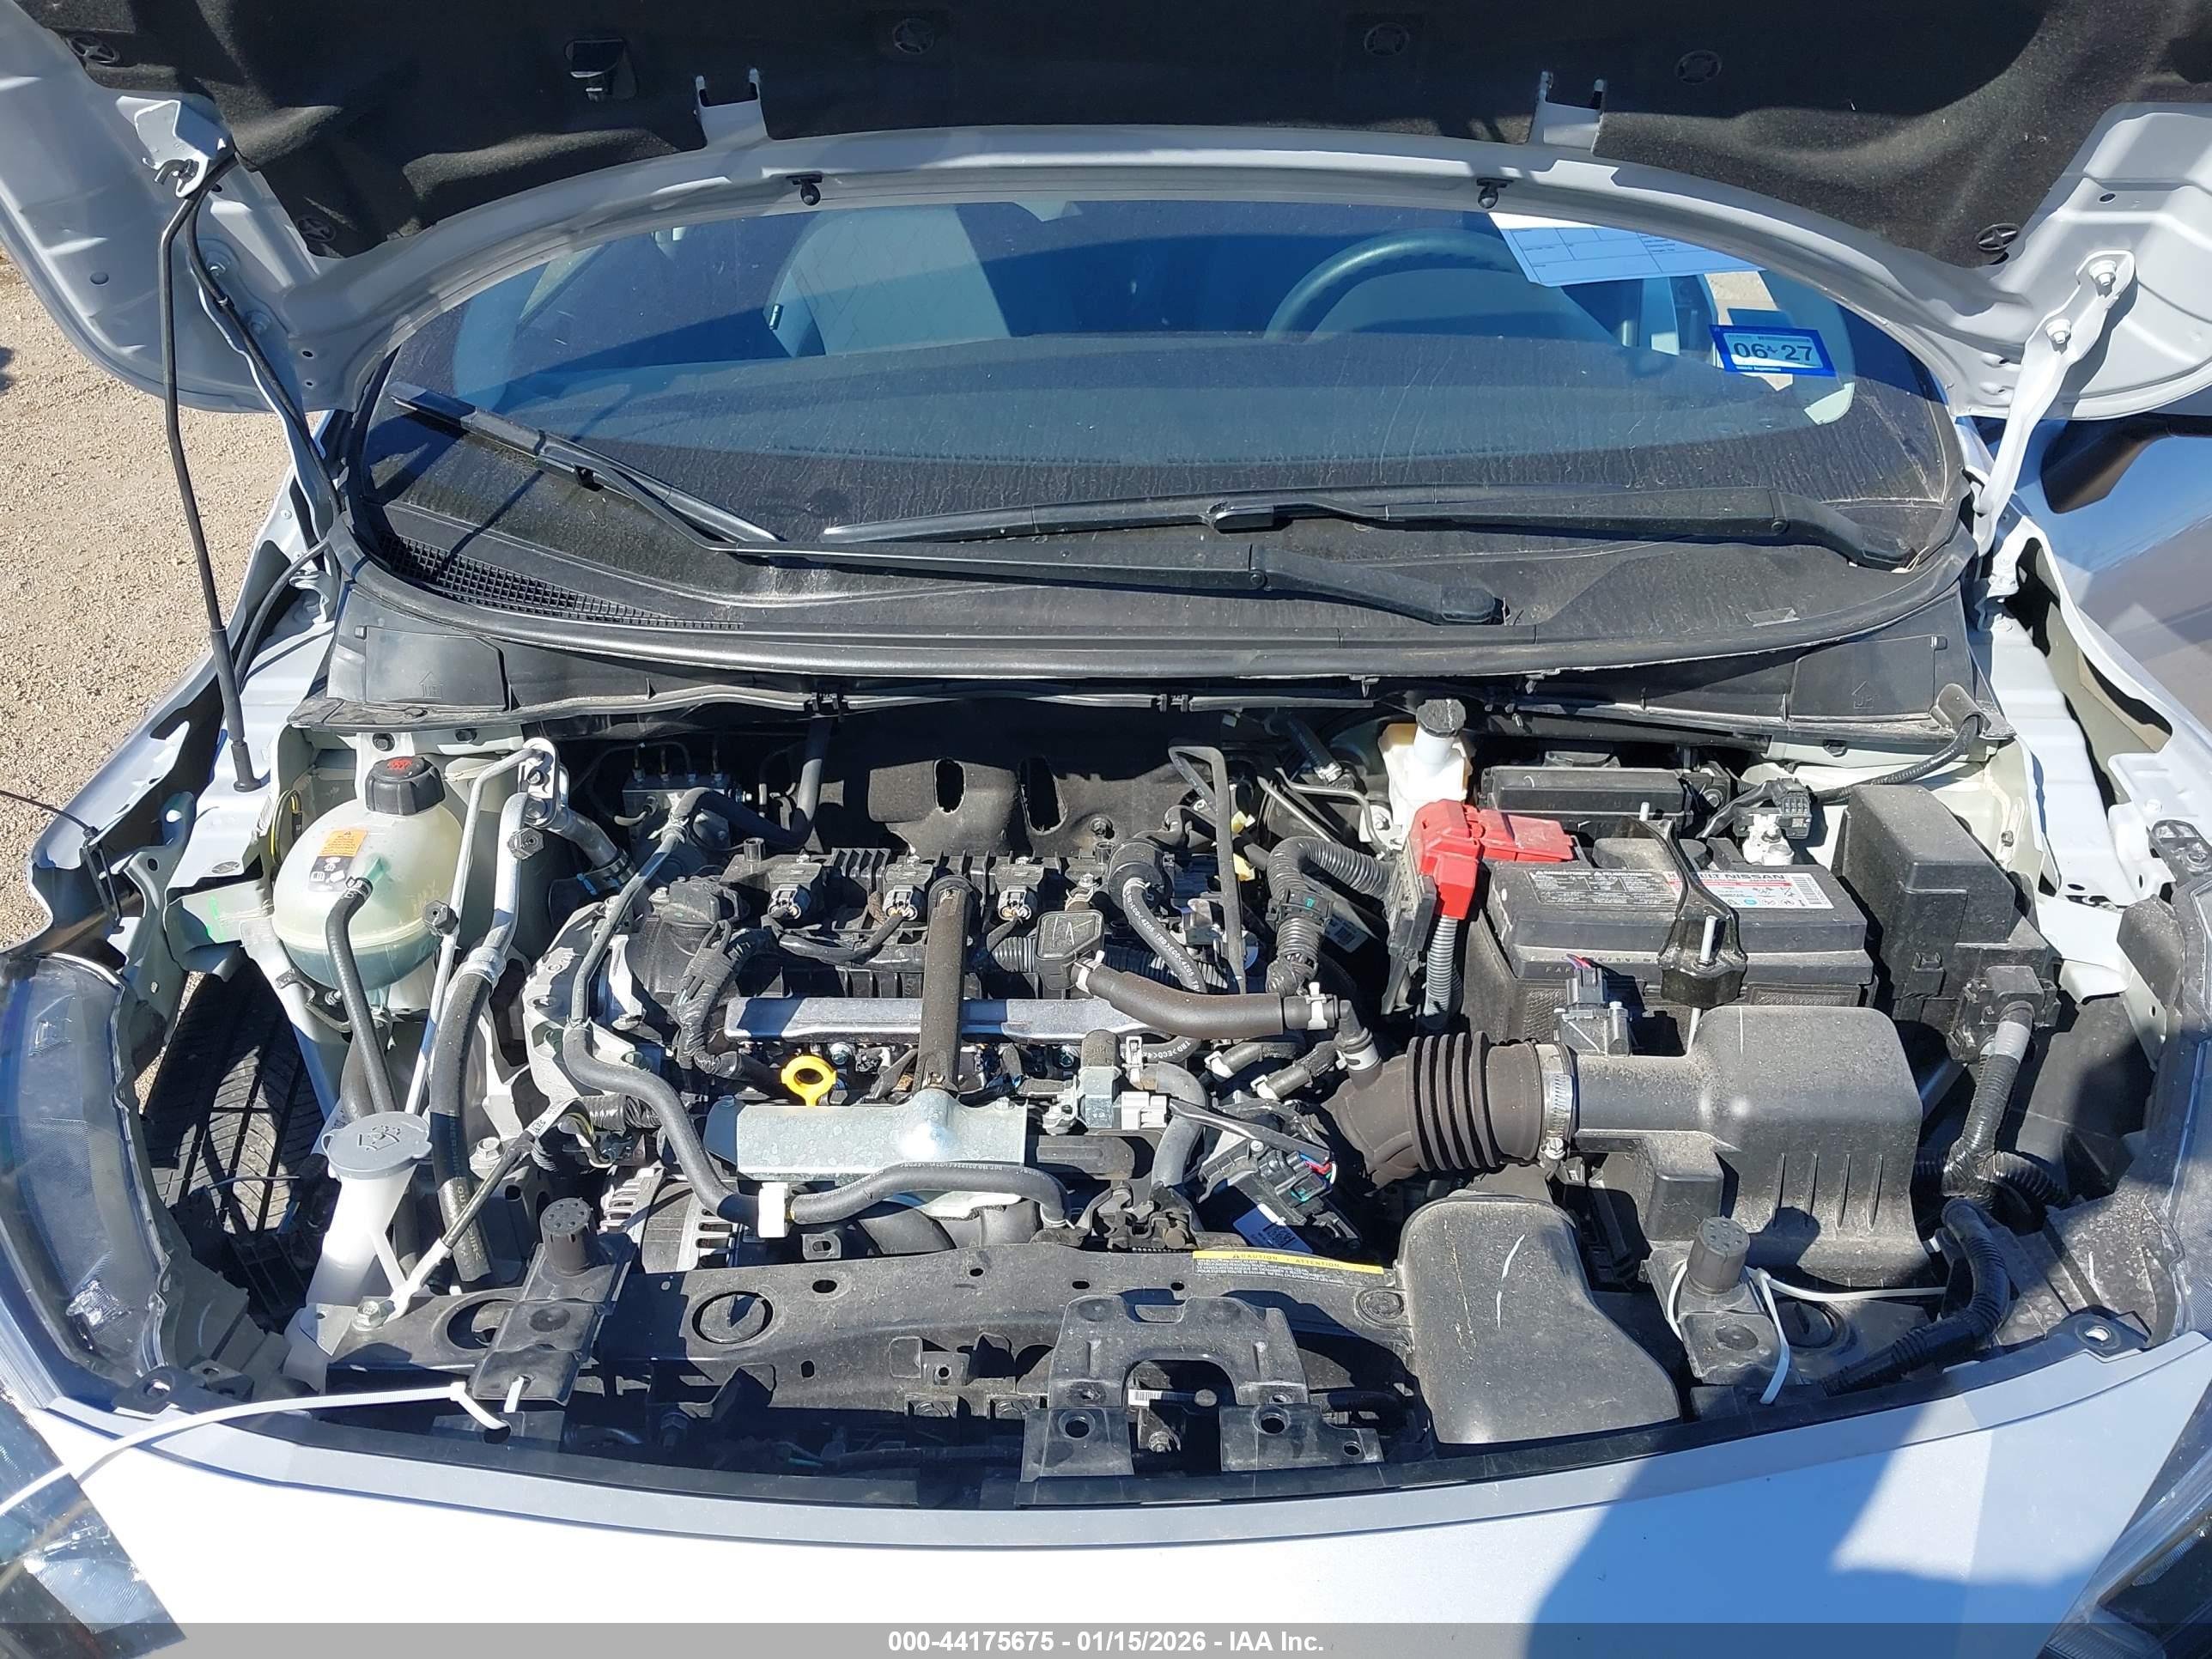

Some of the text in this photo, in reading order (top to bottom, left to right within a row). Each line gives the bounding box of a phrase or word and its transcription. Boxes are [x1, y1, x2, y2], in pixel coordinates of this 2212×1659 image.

[1734, 342, 1813, 362] 06 27
[1295, 1258, 1340, 1268] ATTENTION
